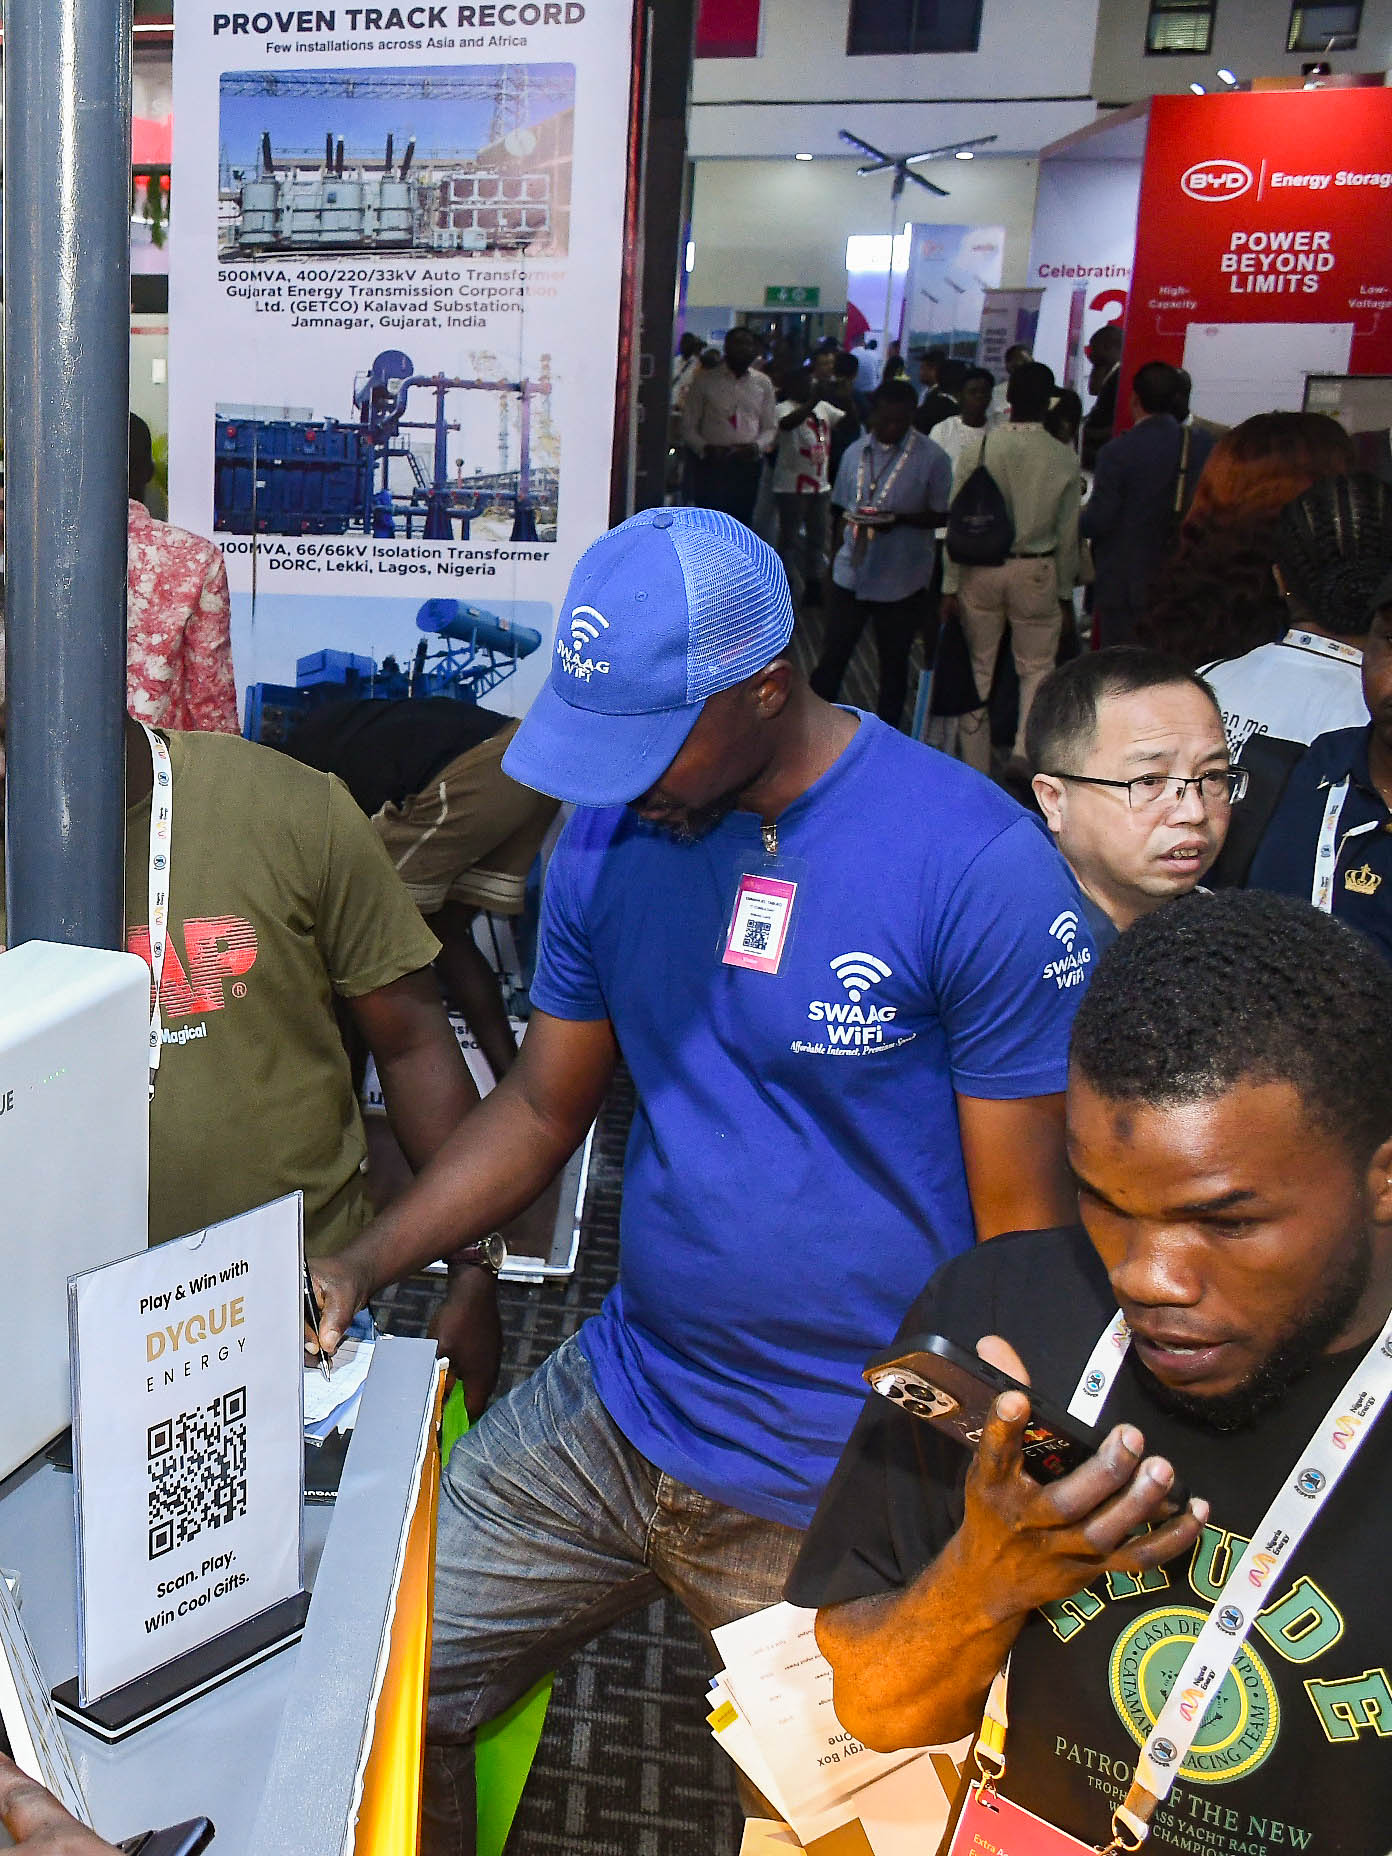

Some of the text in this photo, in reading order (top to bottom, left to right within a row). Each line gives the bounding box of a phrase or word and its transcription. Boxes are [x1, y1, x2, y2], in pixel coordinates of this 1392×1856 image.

[212, 2, 586, 36] PROVEN TRACK RECORD
[265, 34, 528, 54] Few installations across Asia and Africa
[1188, 171, 1245, 189] BYD
[1271, 171, 1332, 189] Energy
[1230, 231, 1332, 252] POWER
[1221, 253, 1336, 273] BEYOND
[218, 269, 291, 286] 500MVA,
[296, 269, 417, 285] 400/220/33kV
[422, 268, 461, 283] Auto
[1230, 273, 1321, 294] LIMITS
[225, 285, 283, 300] Gujarat
[287, 284, 343, 300] Energy
[348, 284, 454, 299] Transmission
[255, 299, 525, 315] Ltd. (GETCO) Kalavad Substation,
[291, 315, 487, 331] Jamnagar, Gujarat, India
[219, 542, 550, 562] 100MVA, 66/66kV Isolation Transformer
[269, 559, 496, 577] DORC, Lekki, Lagos, Nigeria
[1244, 717, 1269, 736] me
[808, 1000, 898, 1025] SWAAG
[826, 1024, 883, 1046] WiFi
[140, 1260, 249, 1315] Play & Win with
[146, 1296, 245, 1363] DYQUE
[147, 1337, 246, 1392] ENERGY
[157, 1550, 237, 1598] Scan. Play.
[144, 1572, 250, 1634] Win Cool Gifts.
[1134, 1621, 1174, 1651] CASA
[1182, 1703, 1266, 1770] ACING TEAM
[816, 1750, 841, 1767] Box
[1087, 1775, 1268, 1856] TROPH YACHT RACE
[1188, 1793, 1239, 1832] THE
[1247, 1815, 1313, 1851] NEW
[973, 1833, 996, 1853] Extra
[1152, 1825, 1238, 1856] CHAMPIO
